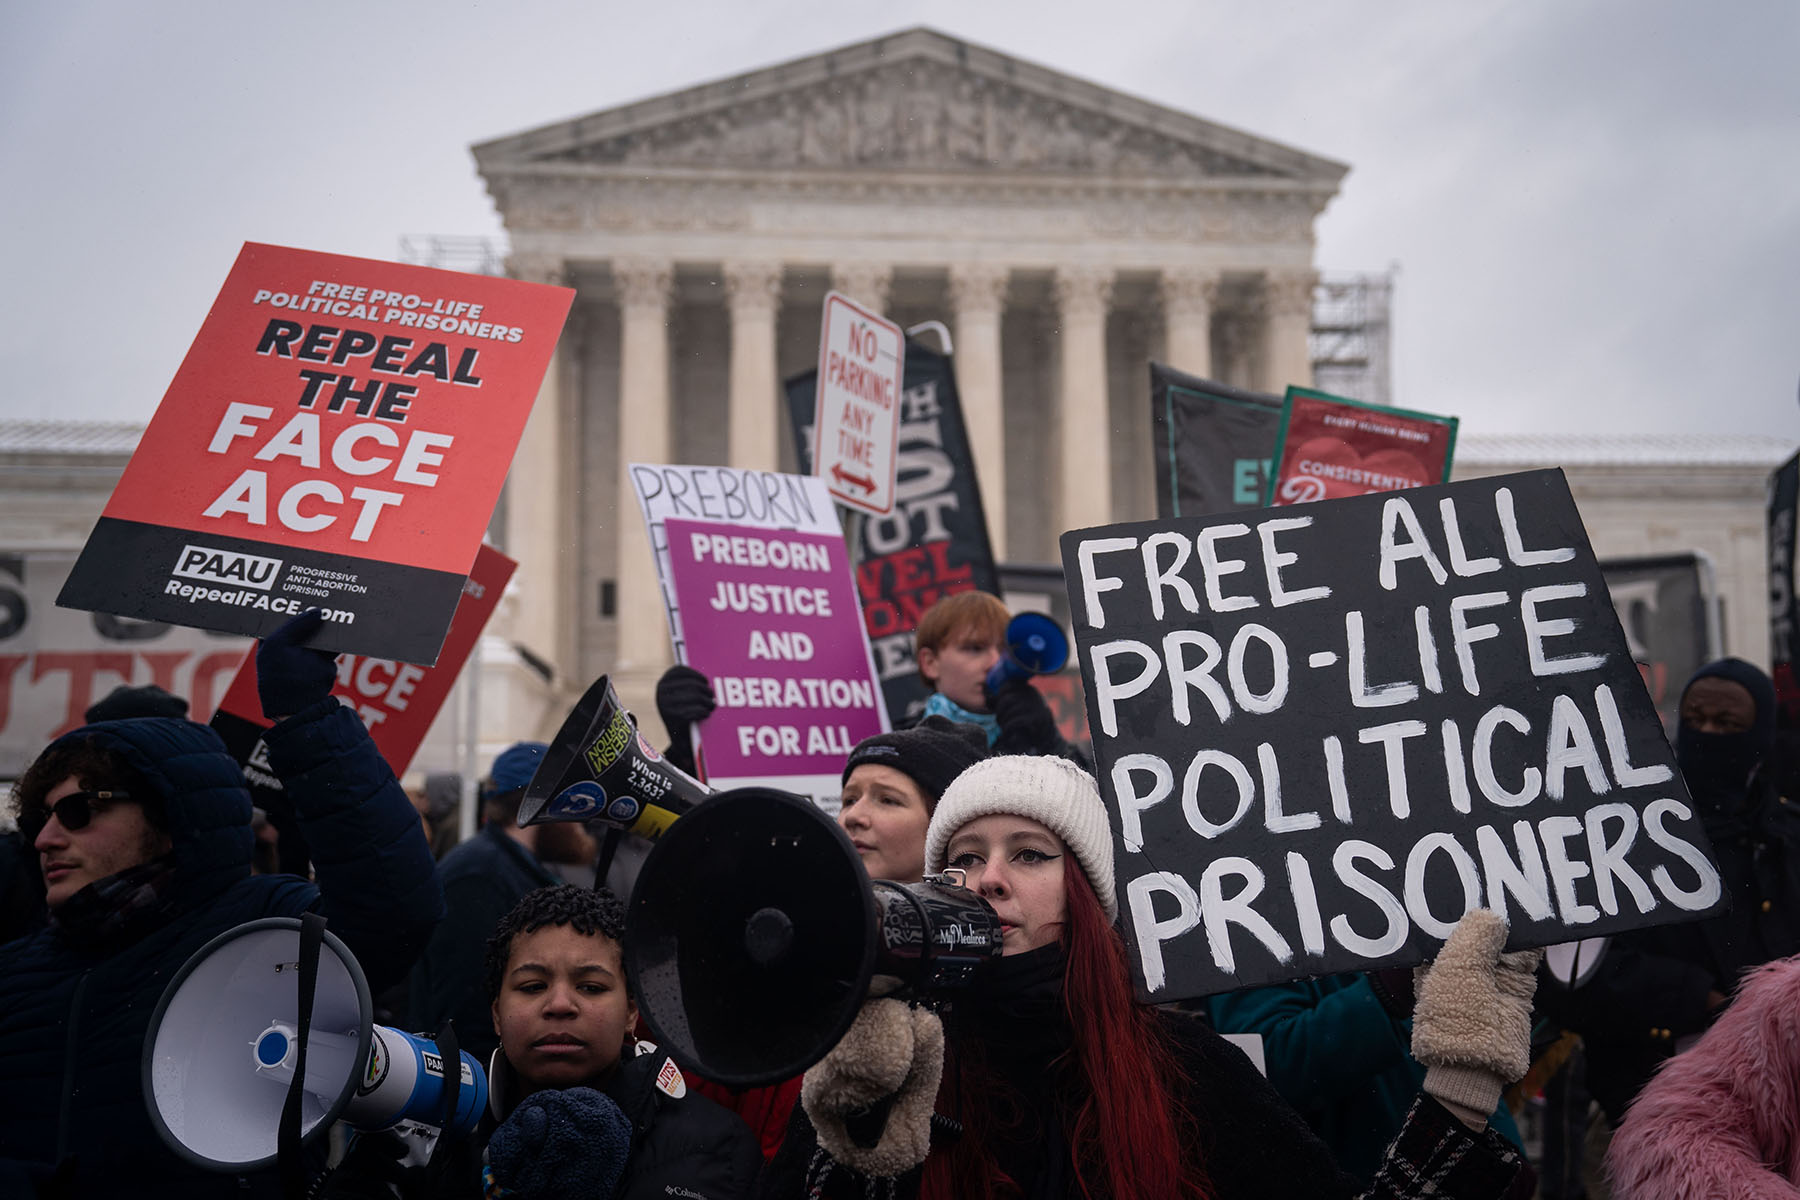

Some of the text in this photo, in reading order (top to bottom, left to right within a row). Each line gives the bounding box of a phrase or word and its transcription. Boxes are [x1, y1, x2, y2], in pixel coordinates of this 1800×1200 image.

[253, 289, 524, 343] POLITICAL PRISONERS
[308, 280, 484, 320] FREE PRO-LIFE
[256, 318, 483, 388] REPEAL
[848, 321, 878, 363] NO
[298, 369, 419, 424] THE
[828, 351, 893, 410] PARKING
[840, 402, 875, 436] ANY
[207, 401, 455, 487] FACE
[837, 428, 874, 468] TIME
[201, 469, 405, 542] ACT
[633, 466, 817, 524] PREBORN
[180, 550, 276, 584] PAAU
[689, 533, 832, 573] PREBORN
[1078, 516, 1333, 629] FREE
[1379, 487, 1576, 591] ALL
[282, 583, 330, 598] UPRISING
[286, 574, 367, 594] ANTI-ABORTION
[290, 565, 359, 583] PROGRESSIVE
[710, 581, 833, 617] JUSTICE
[748, 630, 815, 661] AND
[1090, 581, 1613, 738] PRO-LIFE
[713, 677, 874, 708] IBERATION
[737, 726, 802, 757] FOR
[807, 726, 856, 756] ALL
[627, 771, 665, 800] 2,363?
[631, 756, 673, 790] What is
[1111, 683, 1675, 853] POLITICAL
[1127, 798, 1722, 994] PRISONERS
[657, 1062, 677, 1089] LIVES
